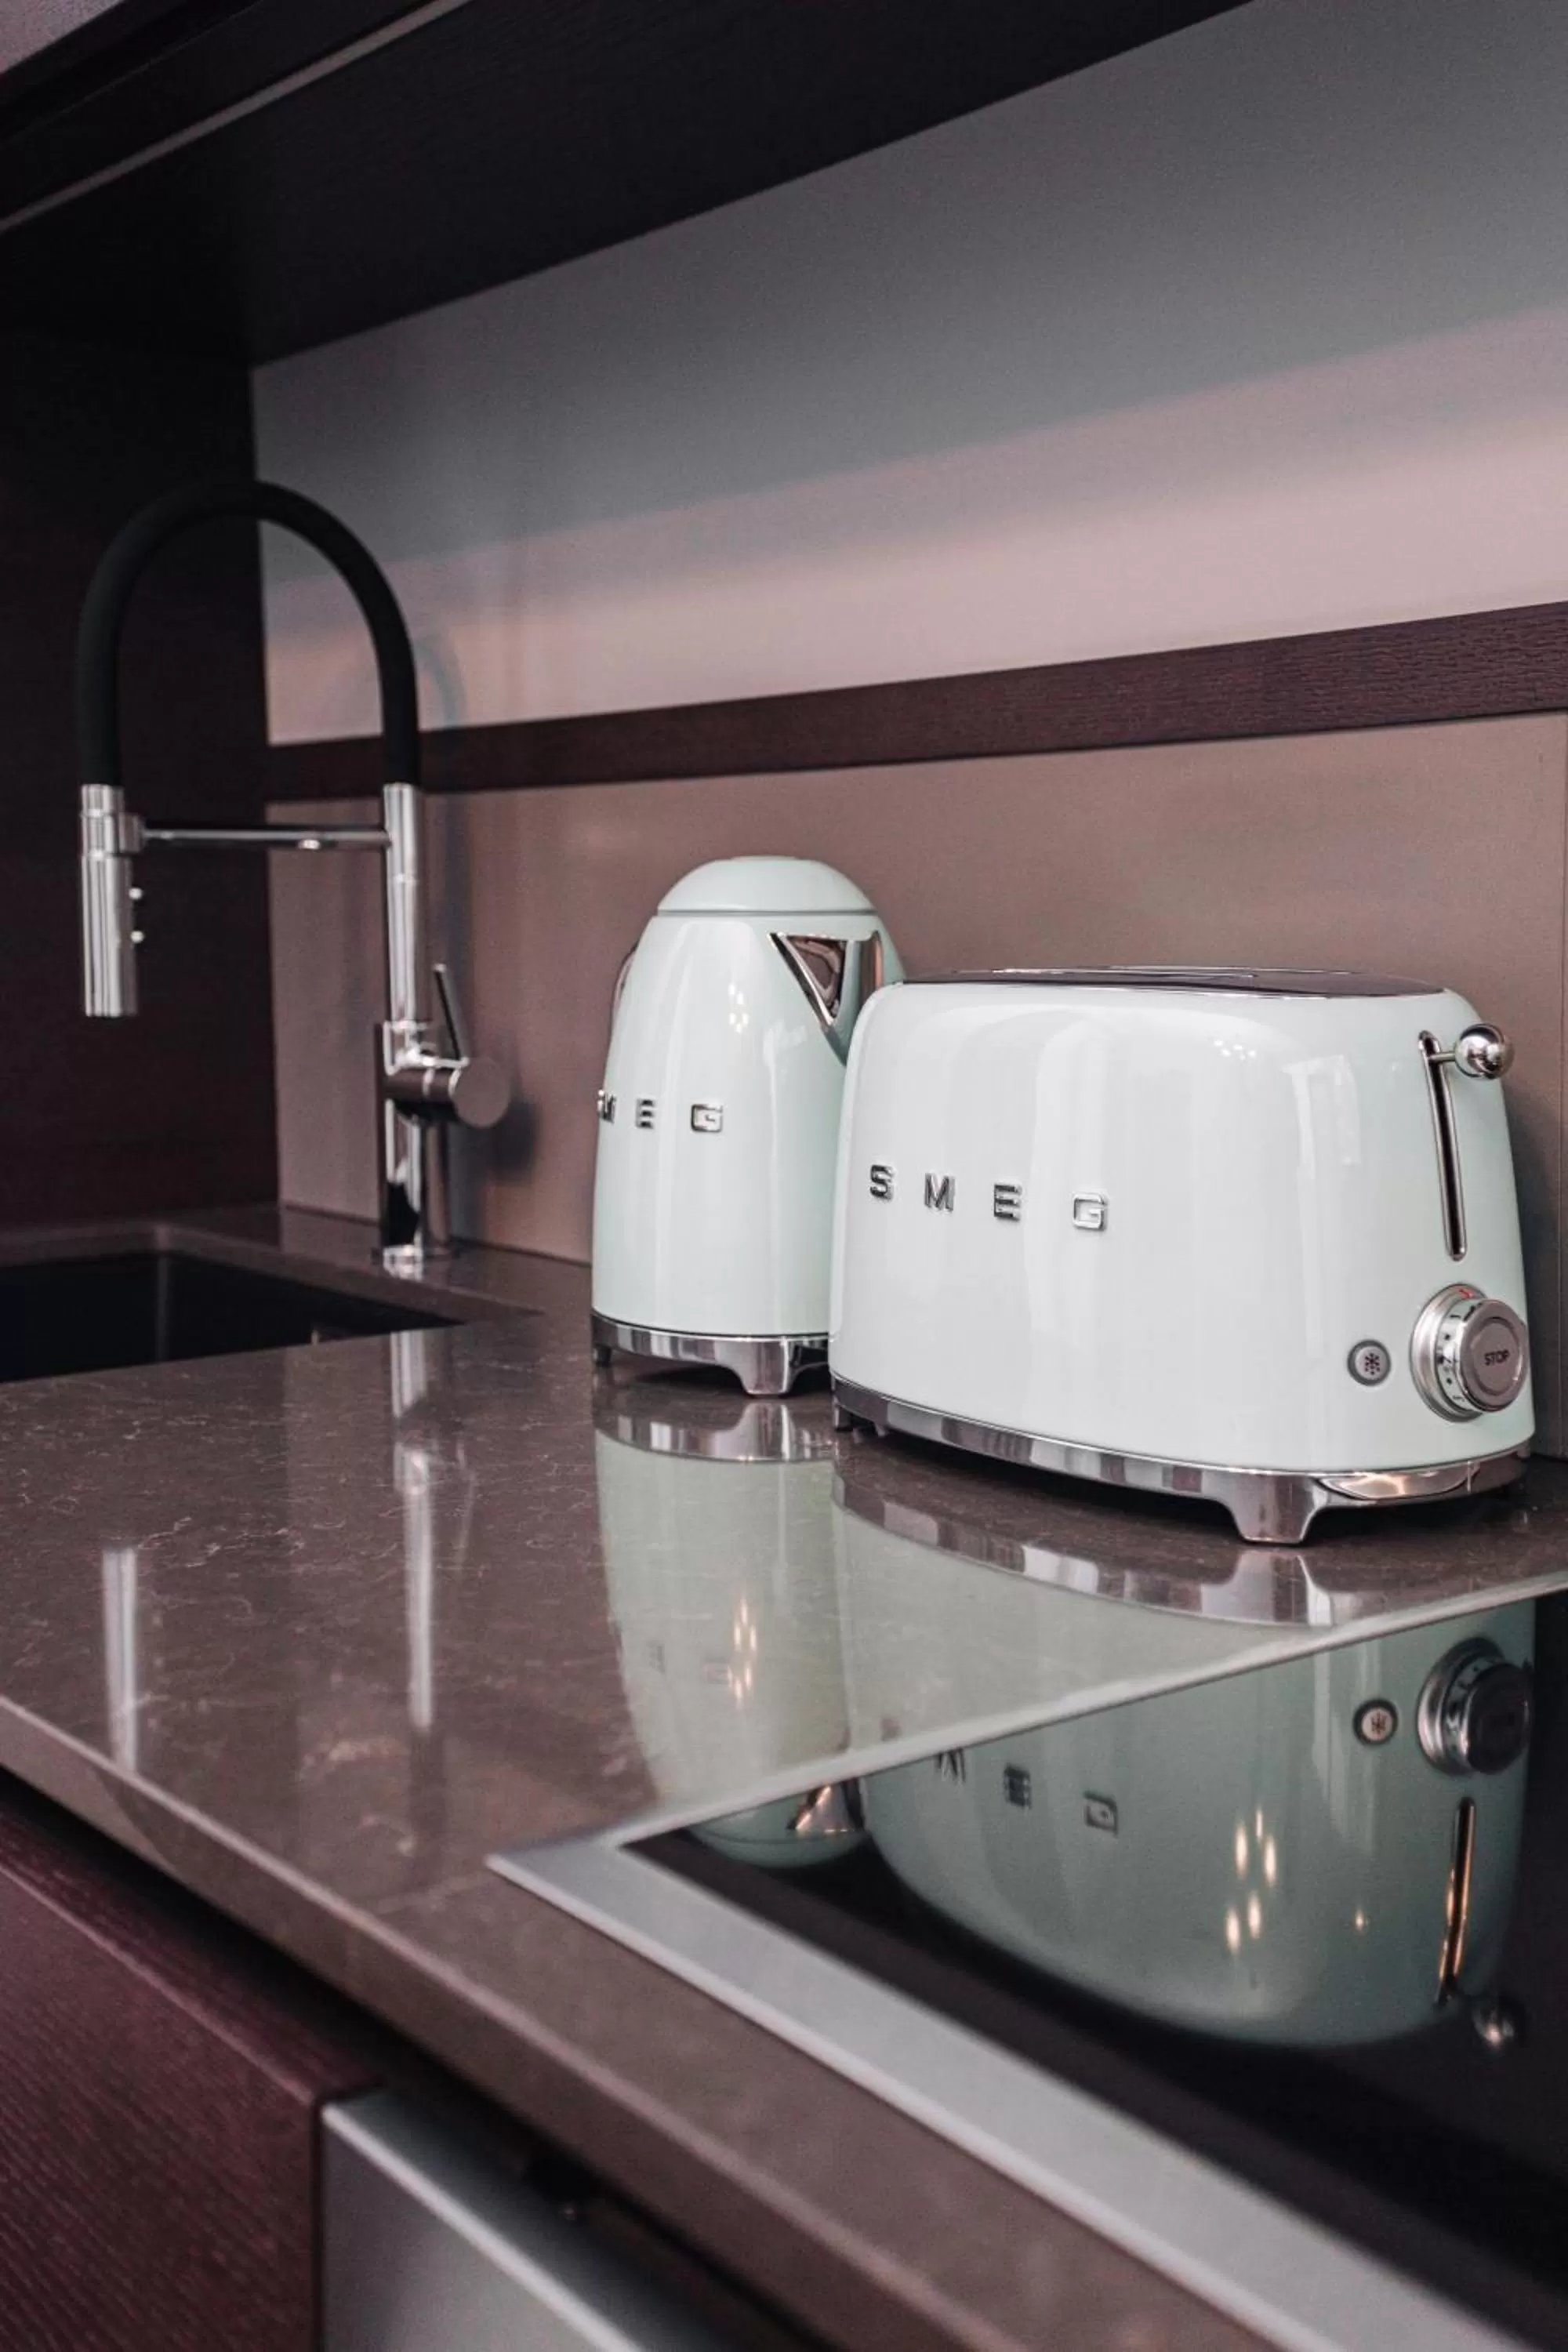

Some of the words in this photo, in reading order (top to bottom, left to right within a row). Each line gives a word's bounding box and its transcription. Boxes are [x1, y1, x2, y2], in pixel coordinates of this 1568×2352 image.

[597, 1090, 723, 1133] MEG
[869, 1163, 1108, 1232] SMEG
[1483, 1348, 1511, 1367] STOP
